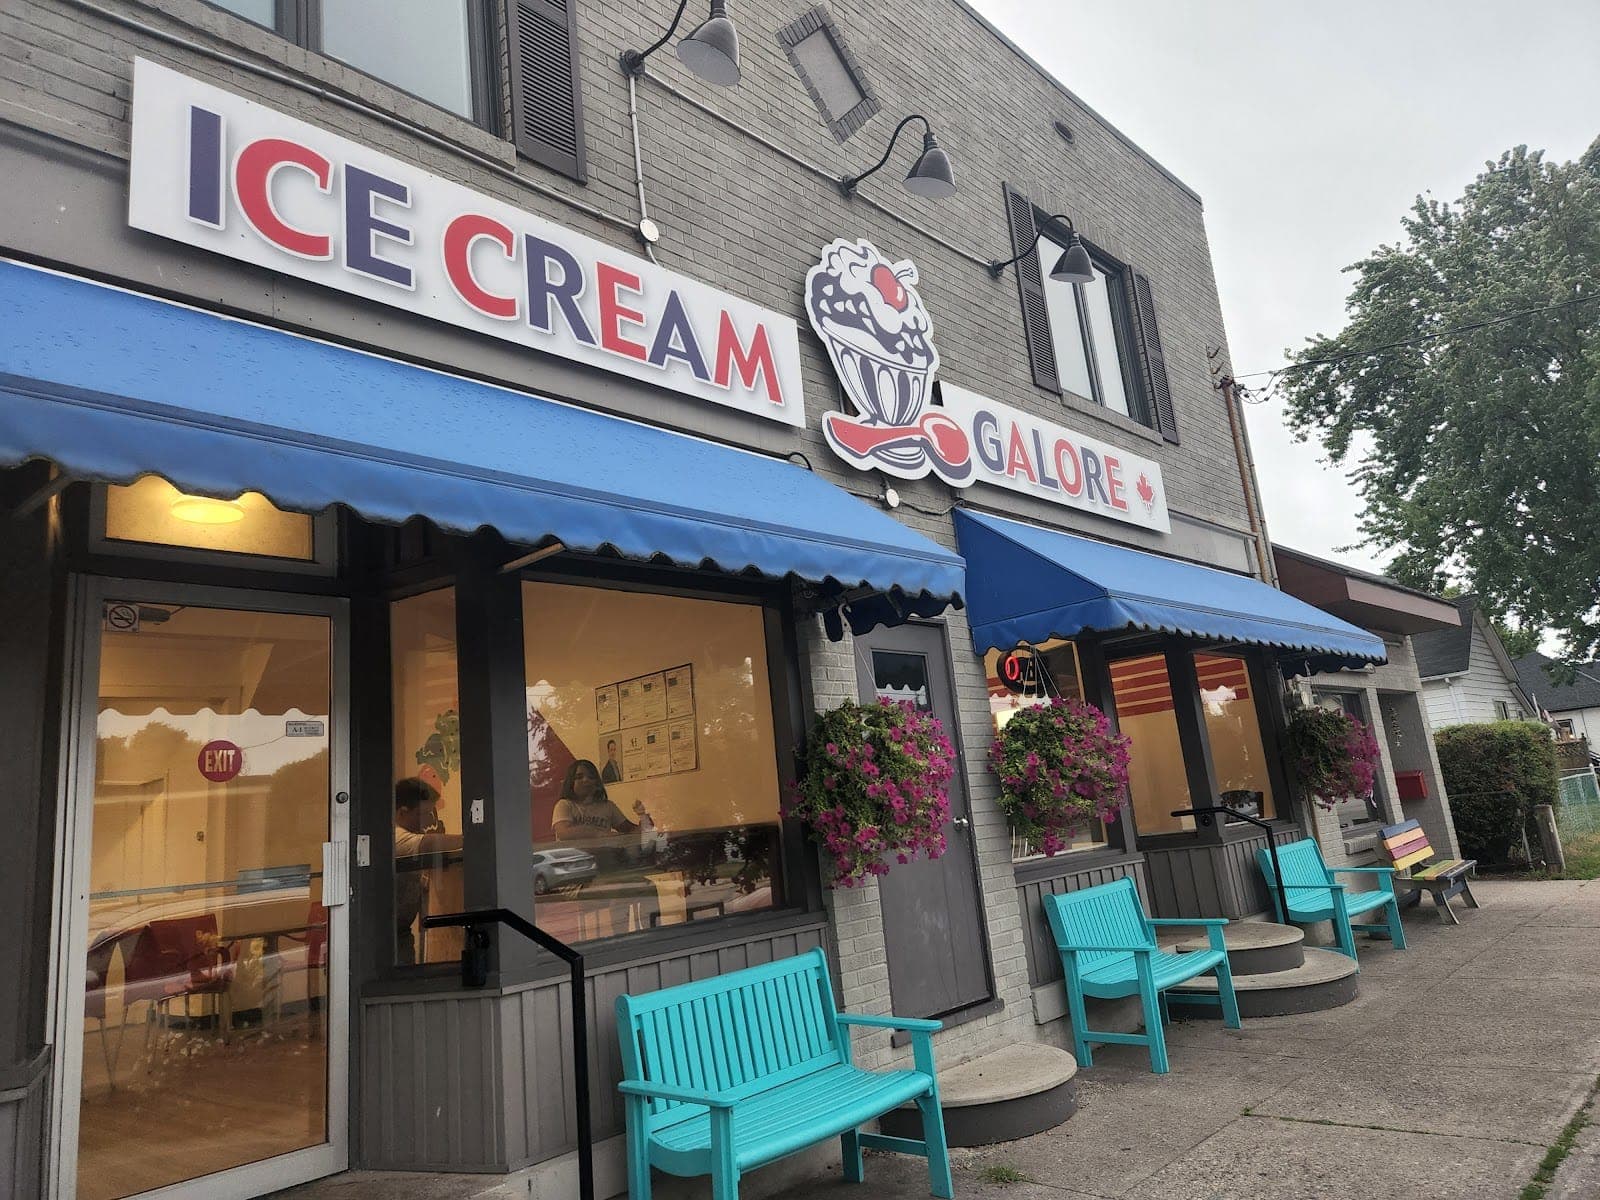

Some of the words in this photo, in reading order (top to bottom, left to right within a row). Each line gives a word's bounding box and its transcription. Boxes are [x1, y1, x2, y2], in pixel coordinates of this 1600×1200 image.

[188, 104, 413, 288] ICE
[443, 213, 783, 404] CREAM
[972, 410, 1128, 510] GALORE
[205, 749, 235, 773] EXIT
